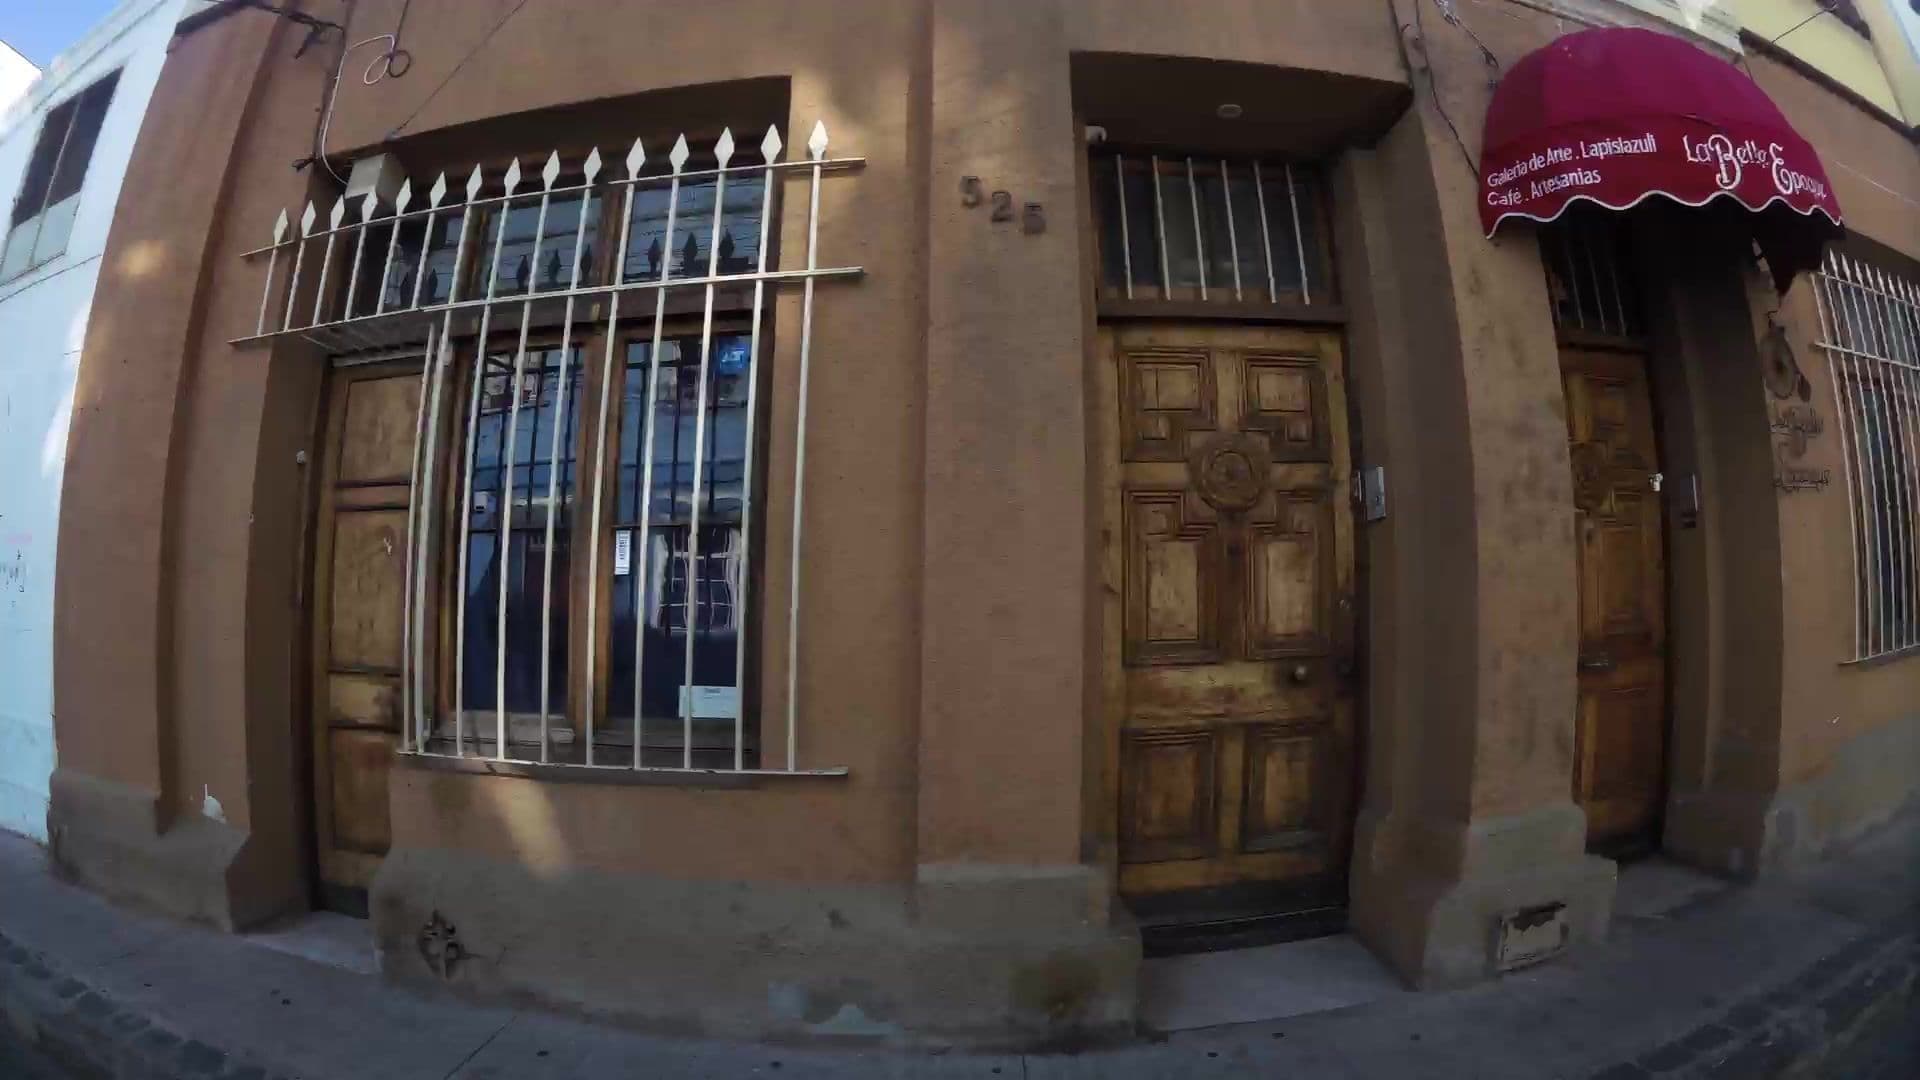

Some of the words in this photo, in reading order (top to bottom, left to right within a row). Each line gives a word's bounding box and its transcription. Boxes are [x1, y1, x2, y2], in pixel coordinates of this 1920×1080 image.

[1529, 153, 1546, 171] de
[1546, 147, 1573, 166] Arte
[1580, 132, 1657, 160] Lapislazuli
[1682, 134, 1712, 163] La
[1487, 187, 1523, 206] Café
[1531, 167, 1602, 199] Artesanias
